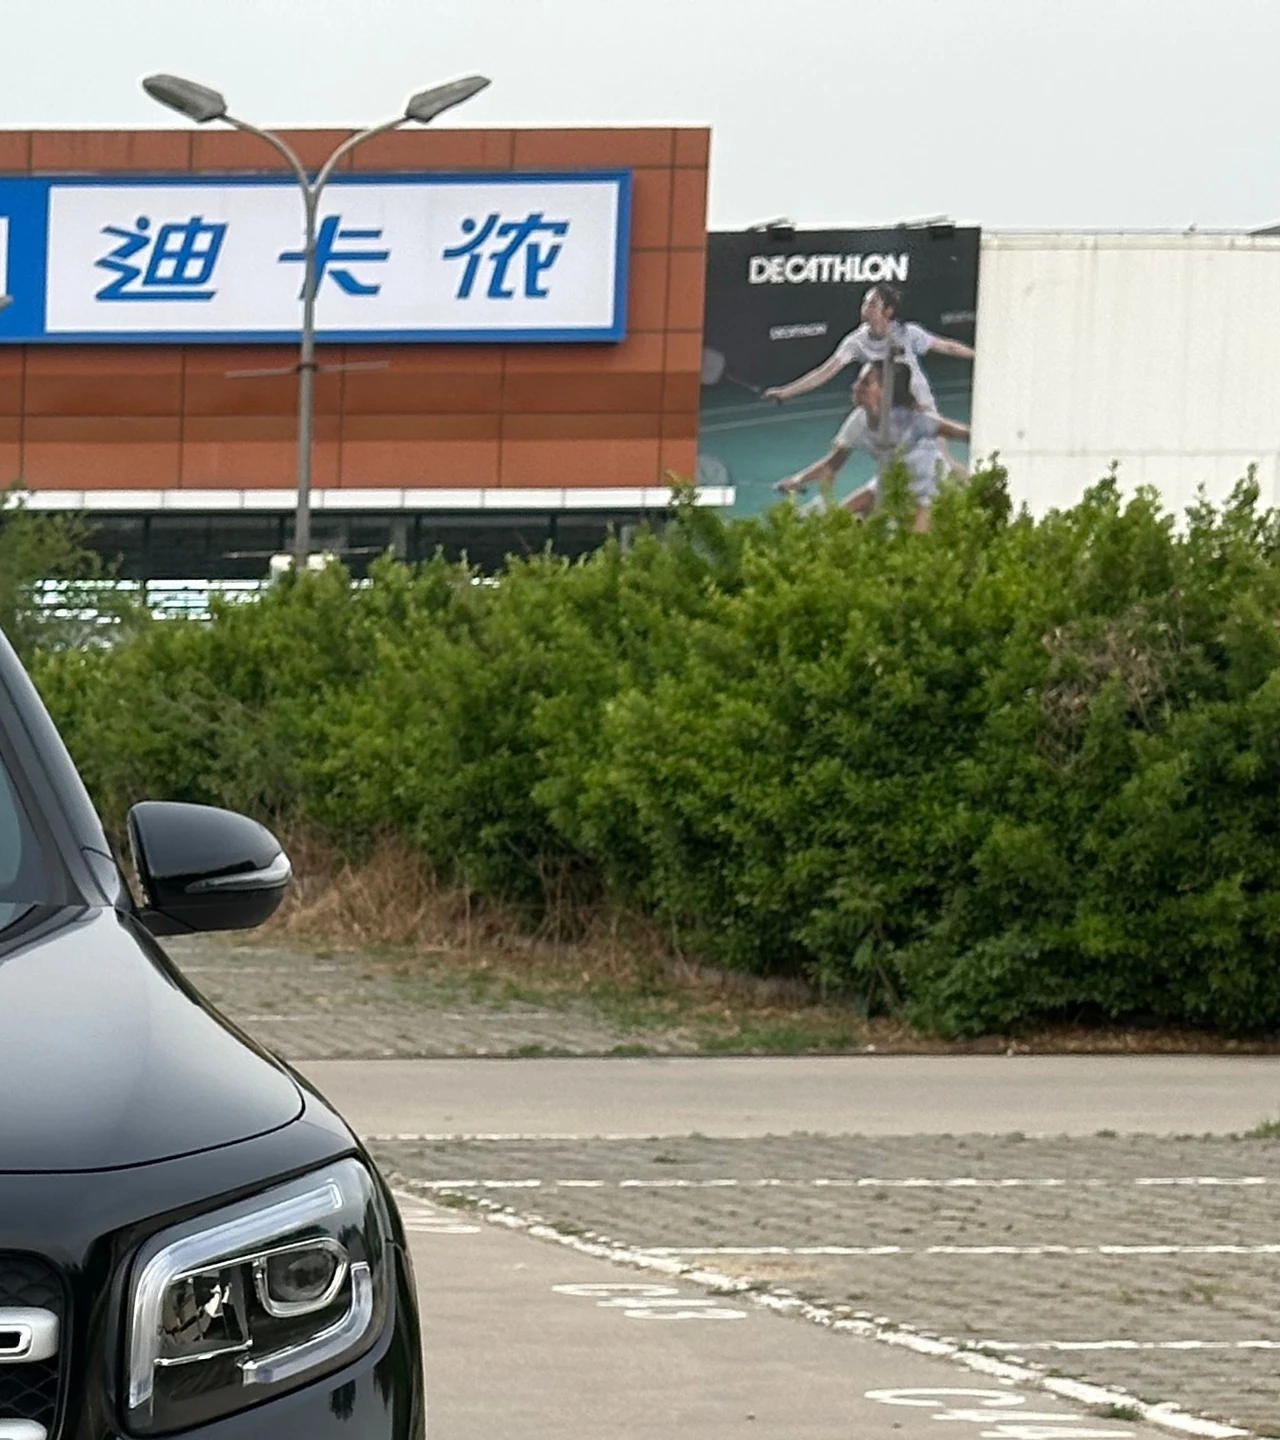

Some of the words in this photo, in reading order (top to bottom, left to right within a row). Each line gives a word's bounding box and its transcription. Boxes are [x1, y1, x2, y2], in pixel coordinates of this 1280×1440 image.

[94, 213, 570, 301] 迪卡侬
[748, 253, 910, 284] DECATHLON
